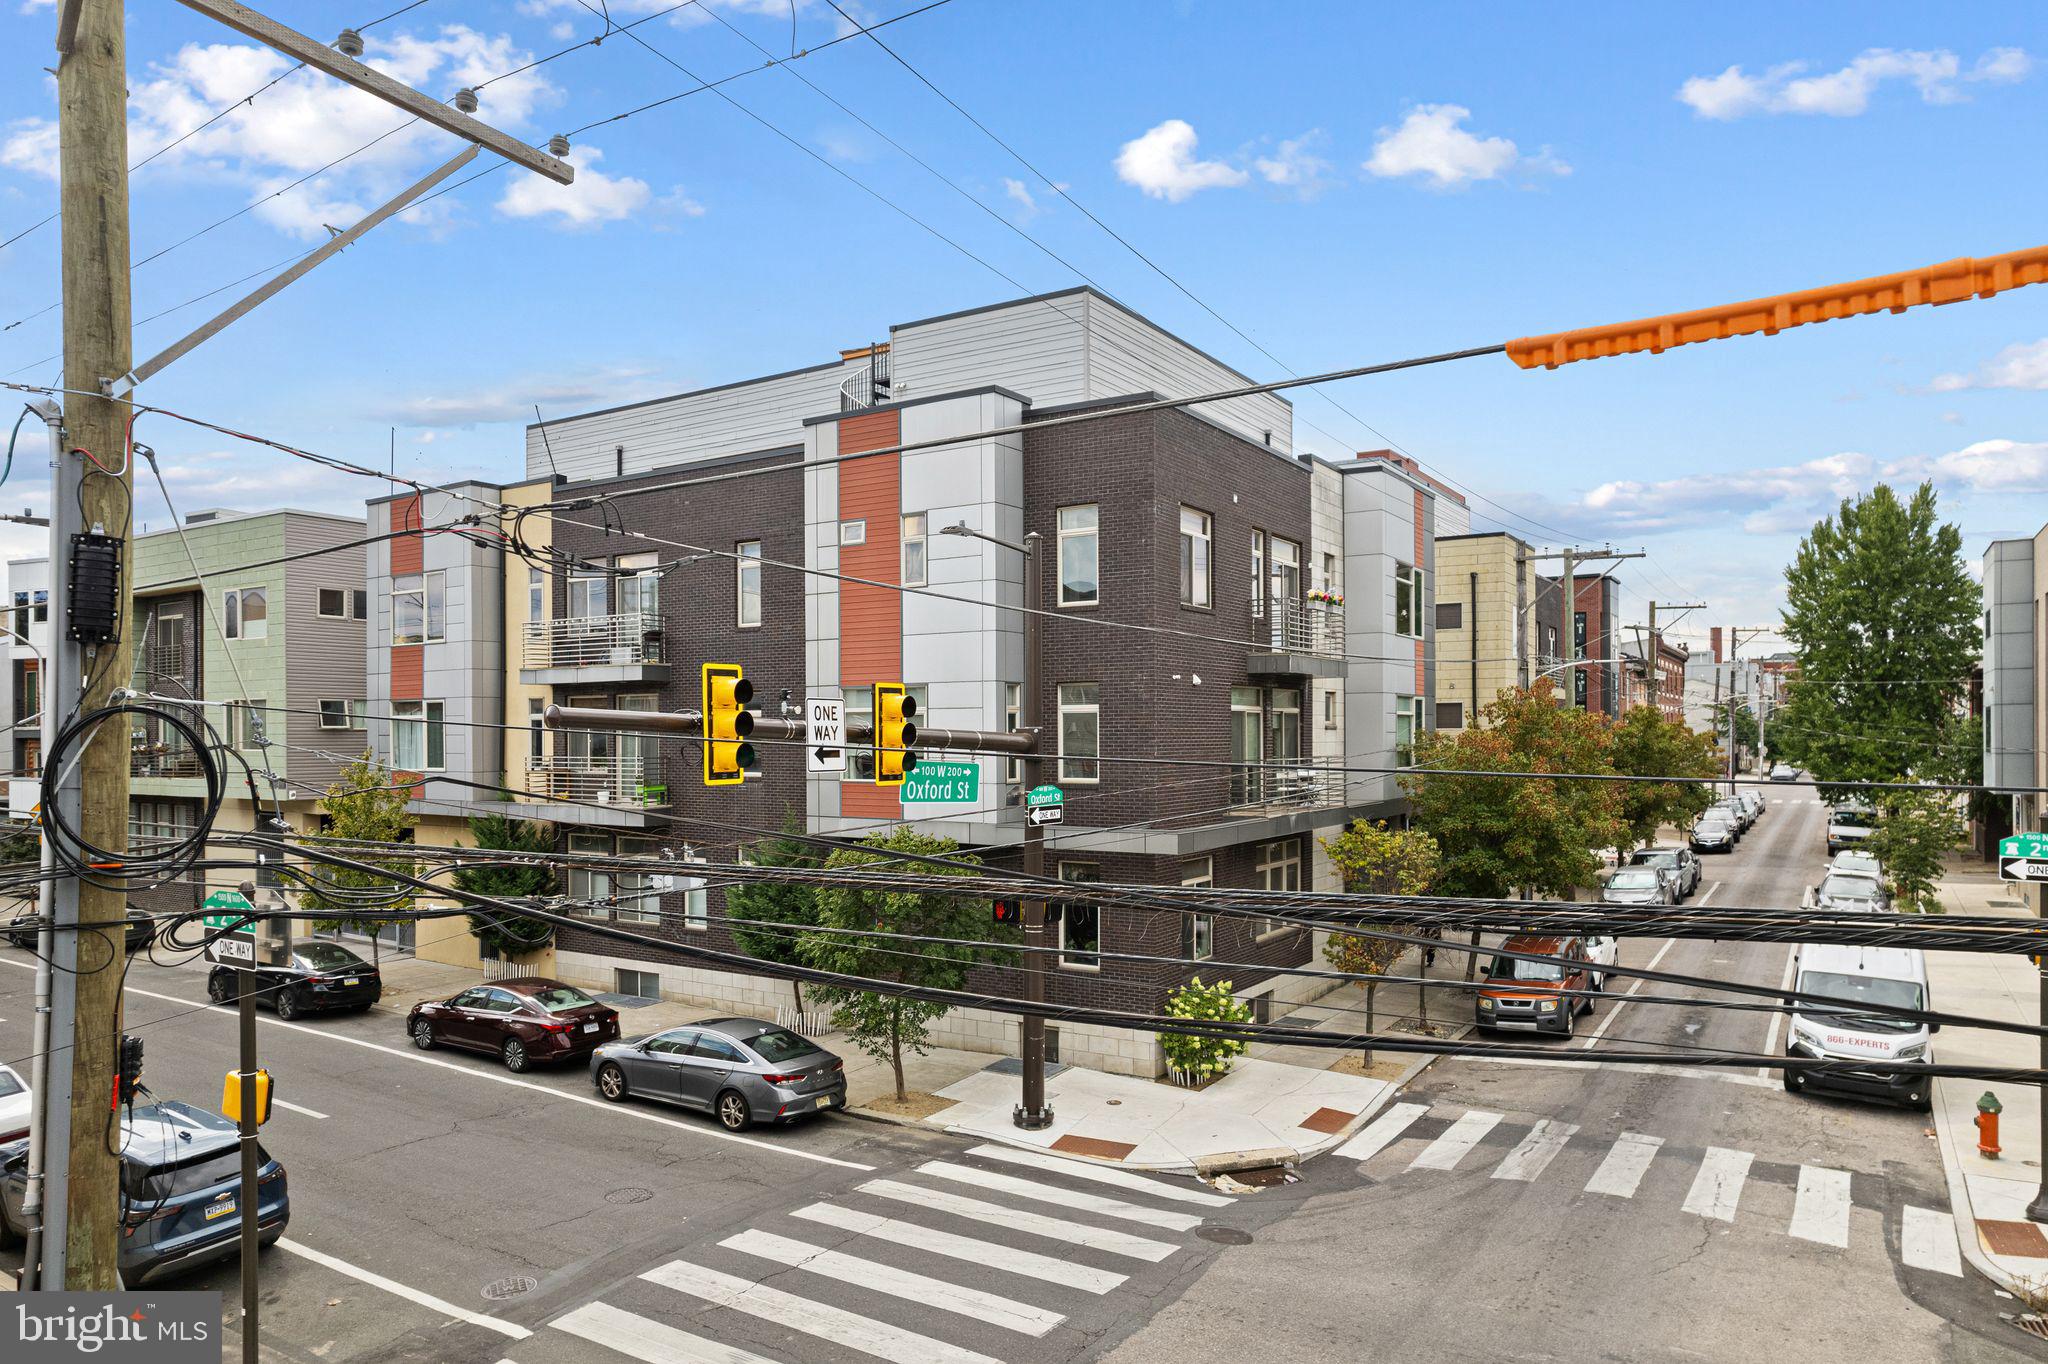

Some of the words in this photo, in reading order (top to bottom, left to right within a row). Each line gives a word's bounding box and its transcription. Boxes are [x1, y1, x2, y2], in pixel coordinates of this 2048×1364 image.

[814, 705, 838, 721] ONE
[814, 725, 838, 741] WAY
[921, 766, 936, 776] 100
[937, 765, 947, 778] W
[947, 767, 962, 777] 200
[906, 780, 952, 799] Oxford
[957, 781, 970, 799] St
[1030, 793, 1053, 805] Oxford
[1054, 792, 1061, 801] St
[1039, 811, 1049, 819] ONE
[1050, 810, 1060, 818] WAY
[219, 940, 234, 955] ONE
[235, 942, 251, 958] WAY
[1826, 1034, 1890, 1051] 866-EXPERTS
